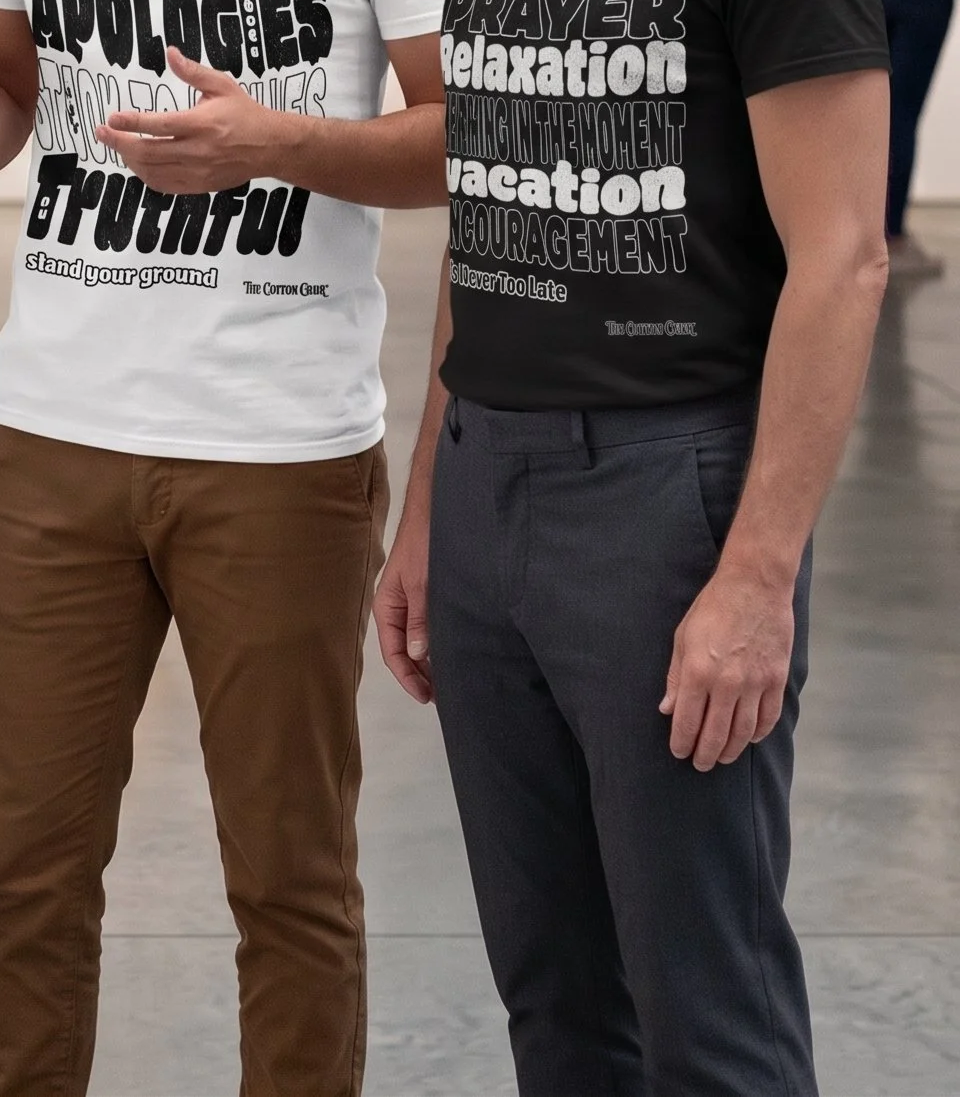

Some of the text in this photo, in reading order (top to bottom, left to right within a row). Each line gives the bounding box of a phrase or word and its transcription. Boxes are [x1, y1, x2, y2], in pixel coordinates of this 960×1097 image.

[440, 33, 687, 98] Relaxation
[535, 100, 579, 168] THE
[578, 101, 687, 171] MOMENT
[445, 157, 687, 216] vacation
[449, 197, 687, 274] NCOURAGEMENT
[26, 252, 219, 289] stand your ground
[497, 271, 527, 296] Too
[528, 275, 568, 302] Late
